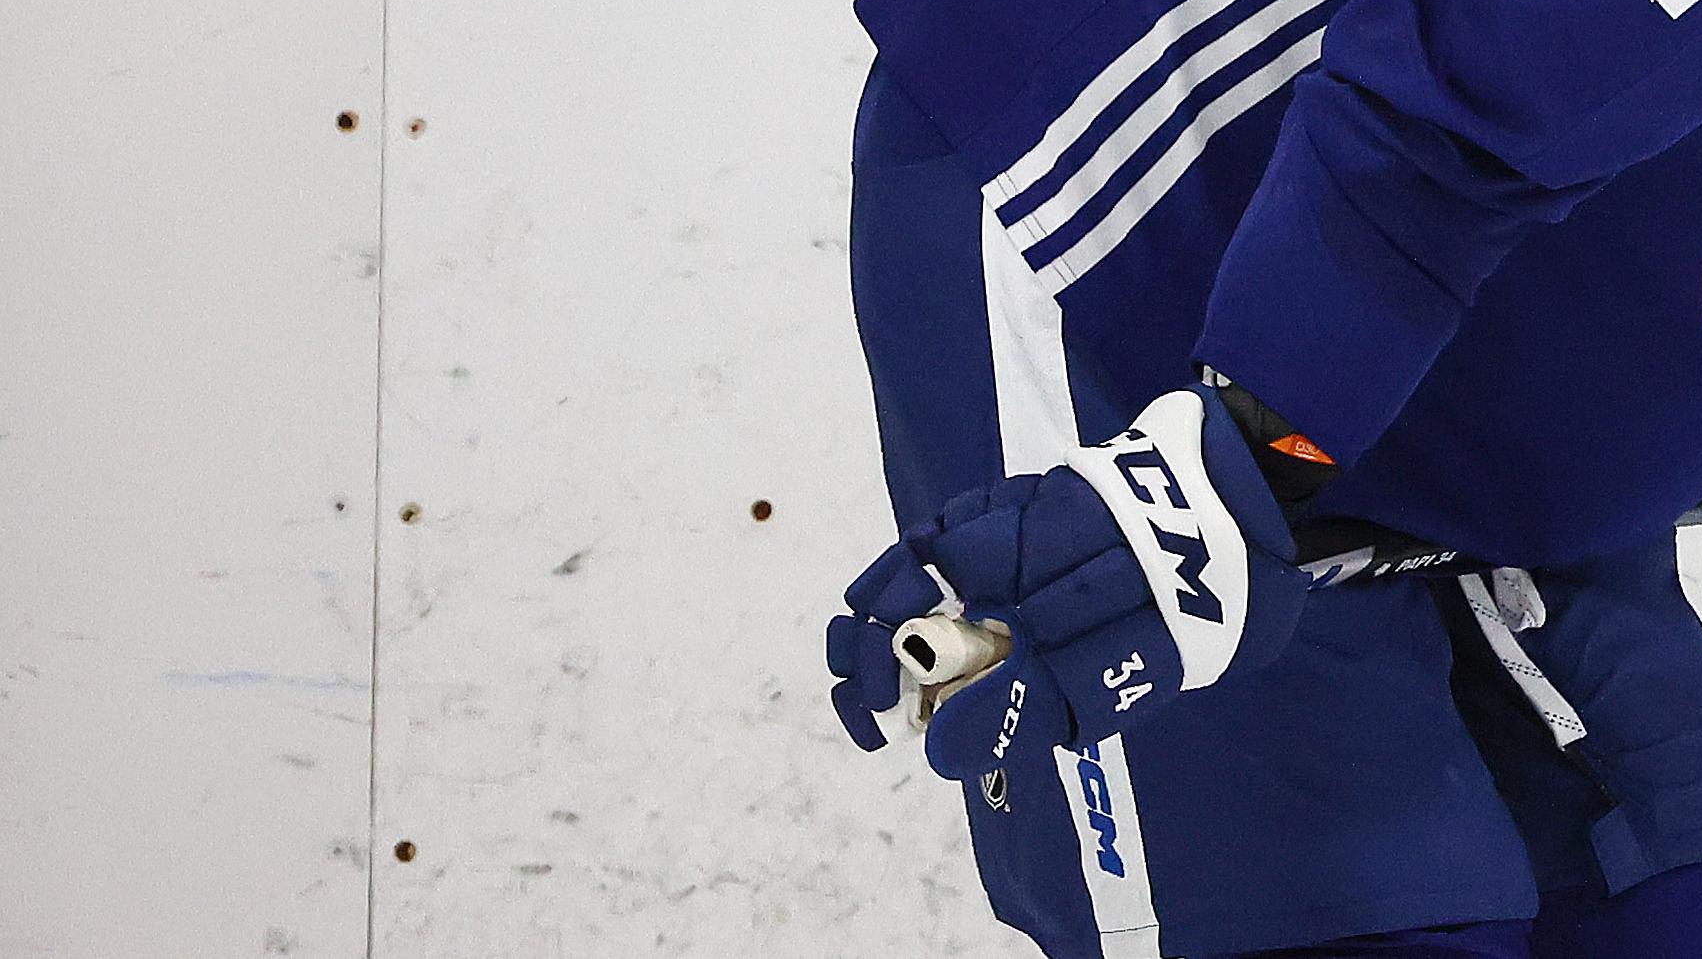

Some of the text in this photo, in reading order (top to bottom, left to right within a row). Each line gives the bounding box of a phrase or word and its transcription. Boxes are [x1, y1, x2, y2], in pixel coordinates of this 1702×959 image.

[1113, 429, 1224, 625] CM
[993, 680, 1027, 759] CCM
[1103, 651, 1153, 712] 34
[1076, 742, 1126, 879] CM
